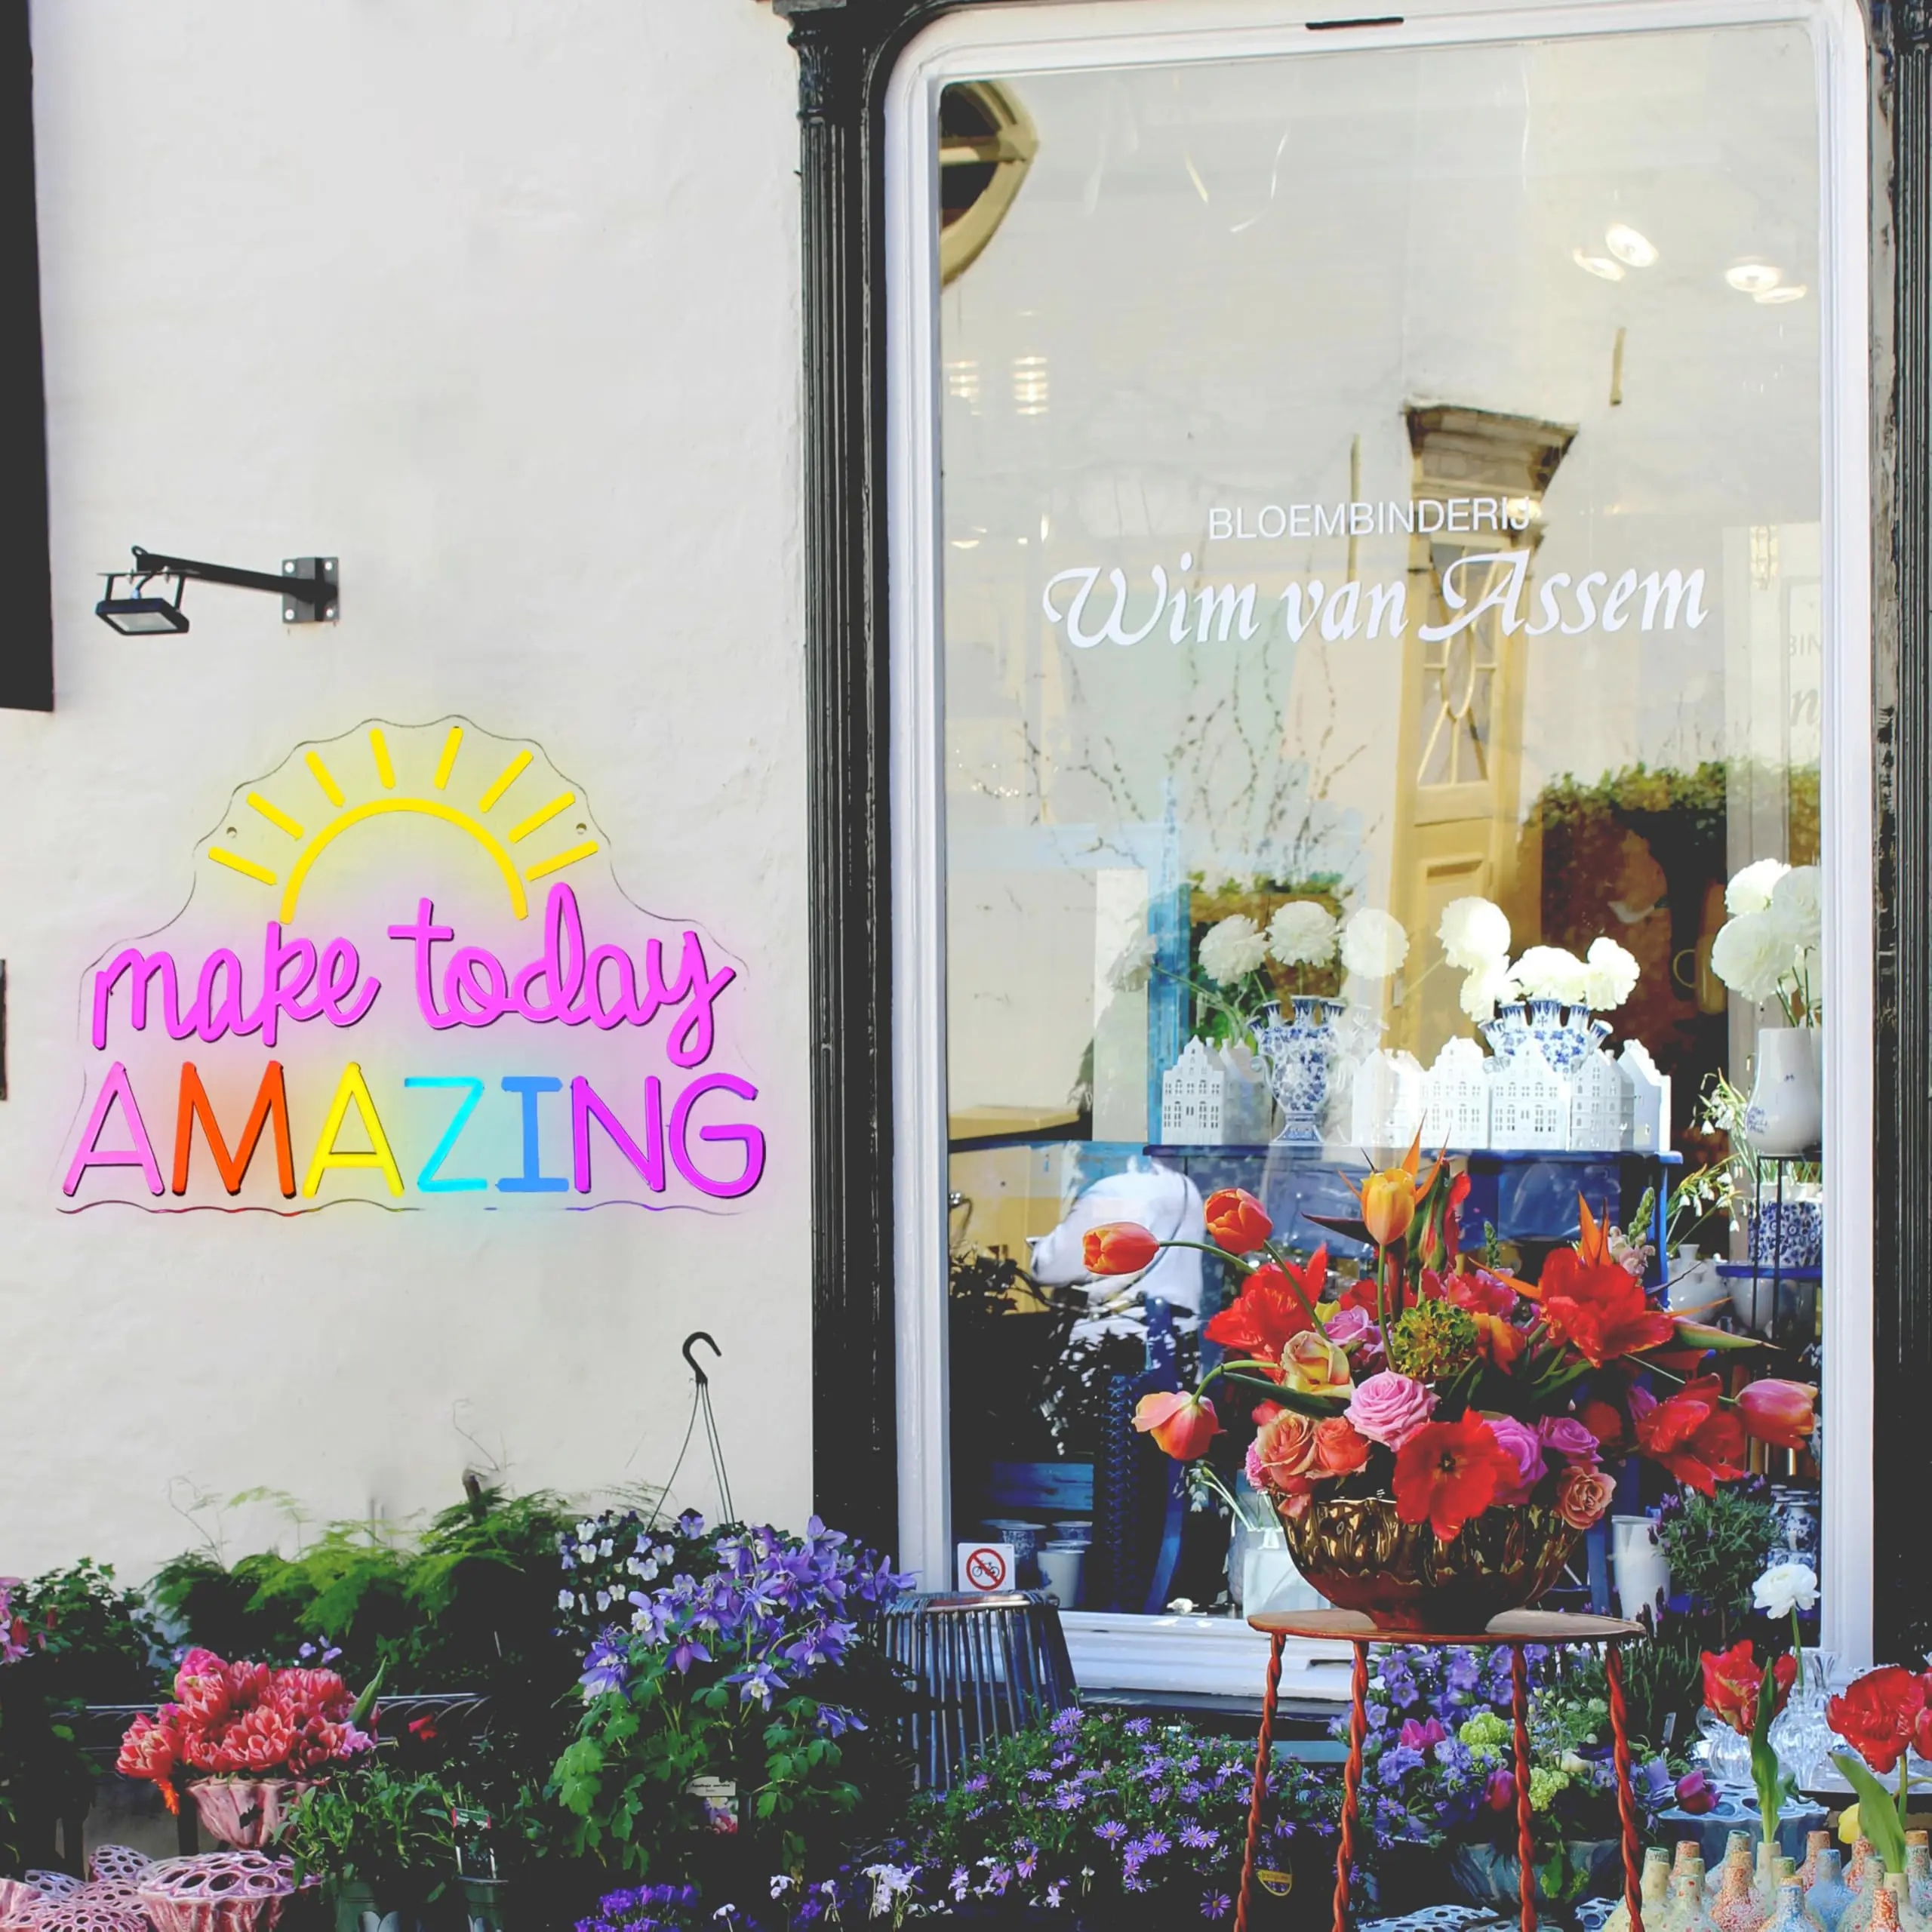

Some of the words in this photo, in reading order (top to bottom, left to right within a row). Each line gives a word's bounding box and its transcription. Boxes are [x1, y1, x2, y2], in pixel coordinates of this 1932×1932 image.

[1208, 497, 1531, 540] BLOEMBINDERIJ
[1042, 552, 1260, 648] Wim
[1278, 580, 1409, 643] van
[1418, 549, 1709, 642] Assem
[93, 921, 381, 1050] make
[388, 882, 736, 1069] today
[63, 1060, 766, 1198] AMAZING
